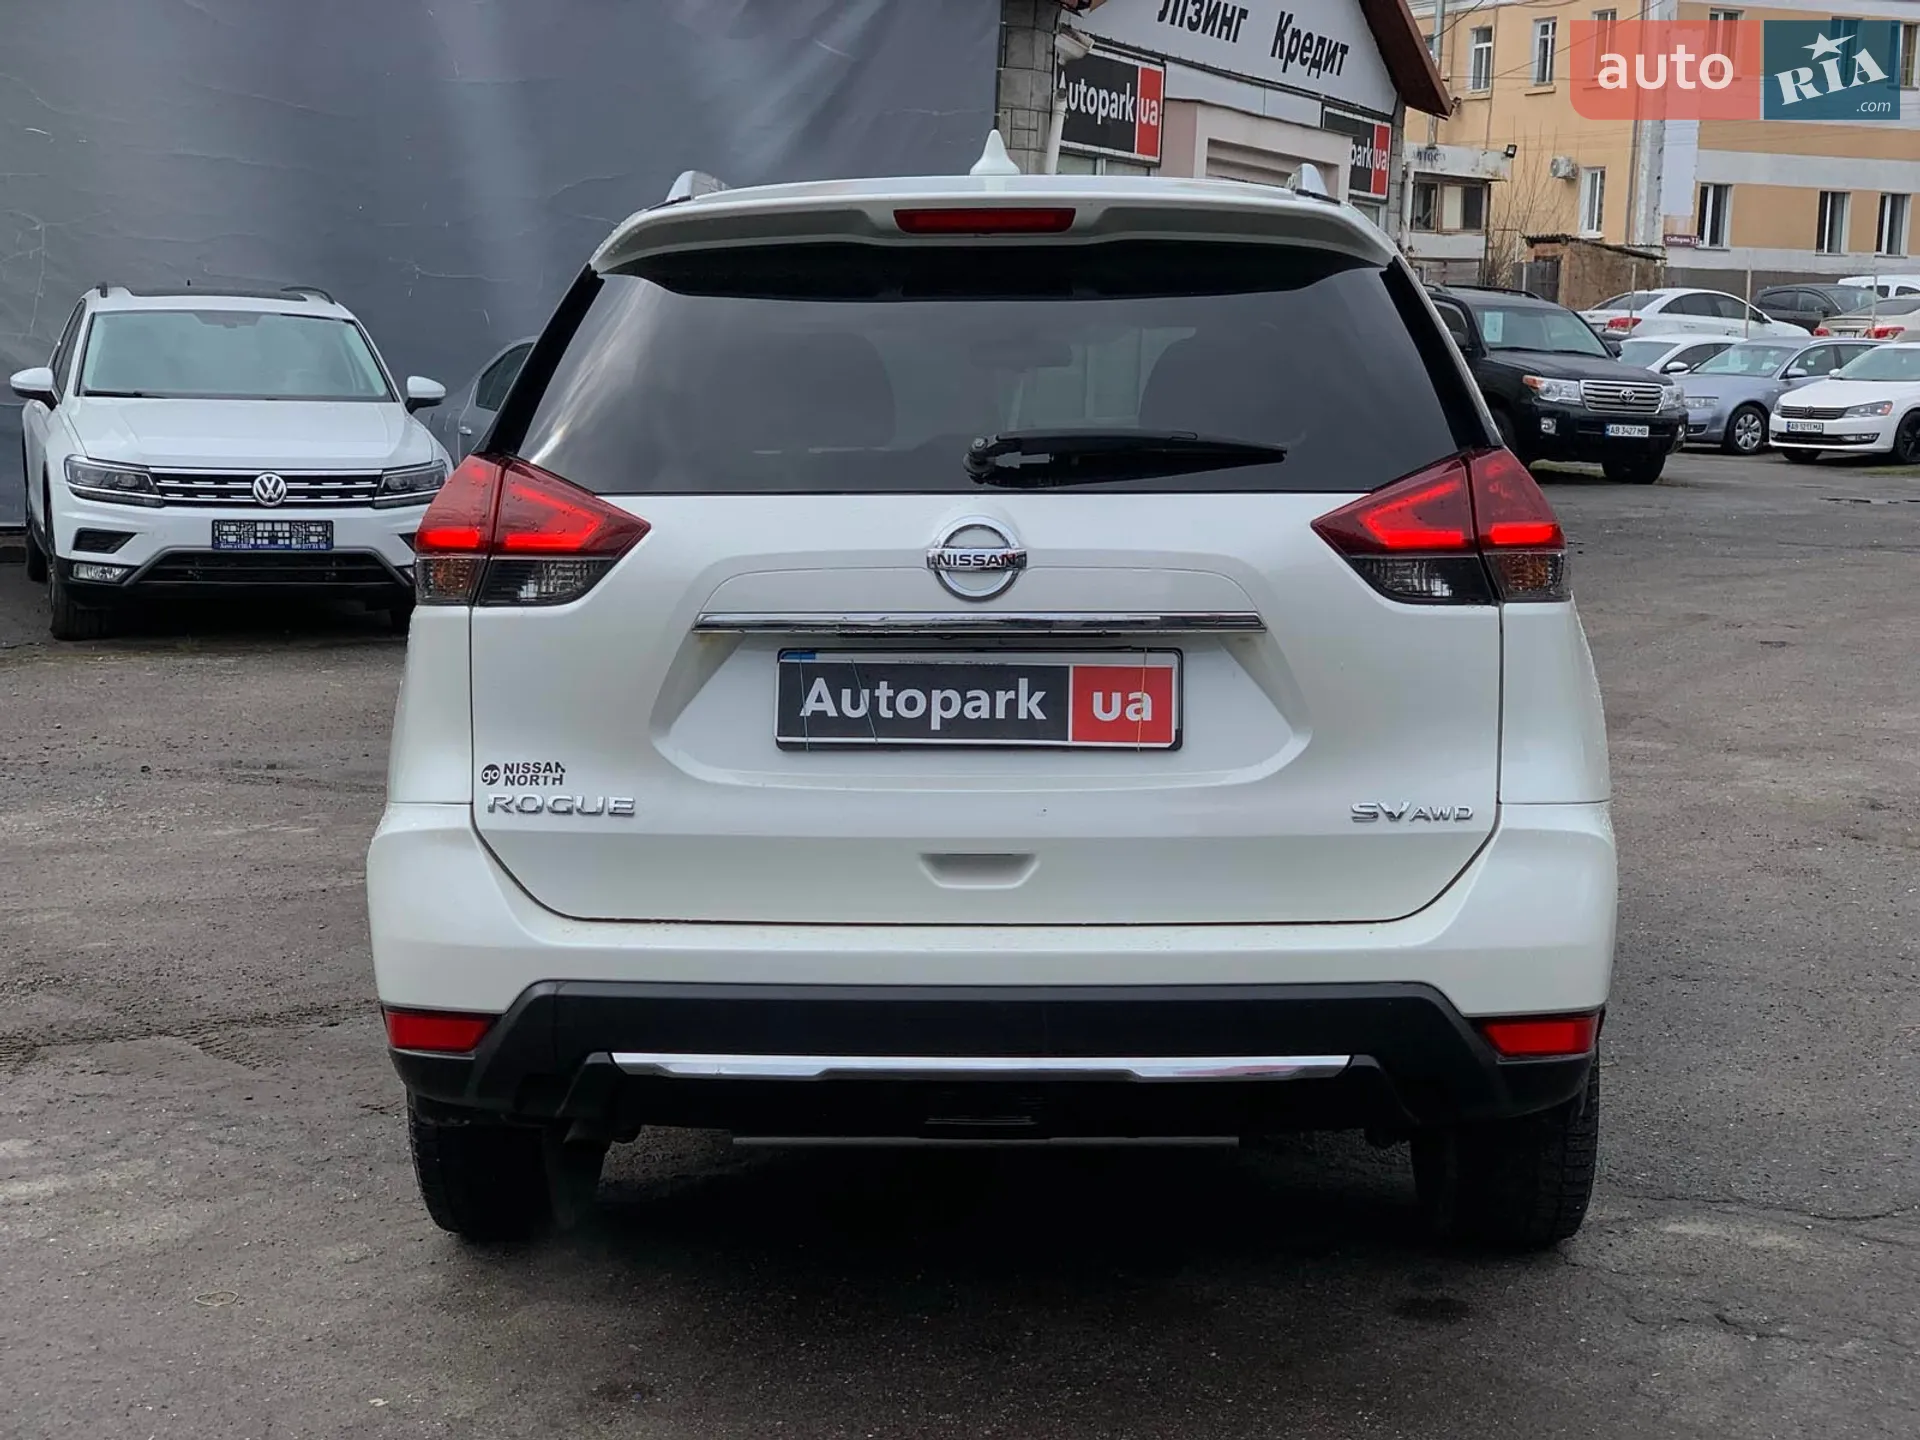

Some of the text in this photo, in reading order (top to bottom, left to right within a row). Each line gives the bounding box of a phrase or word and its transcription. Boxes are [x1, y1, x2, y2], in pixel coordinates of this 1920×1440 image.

[1270, 10, 1350, 79] Кредит
[1140, 97, 1158, 126] ua
[1375, 148, 1388, 171] ua
[937, 554, 1016, 566] NISSAN
[799, 677, 1153, 731] Autopark ua
[503, 761, 566, 775] NISSAN
[504, 774, 564, 787] NORTH
[487, 793, 635, 816] ROGUE
